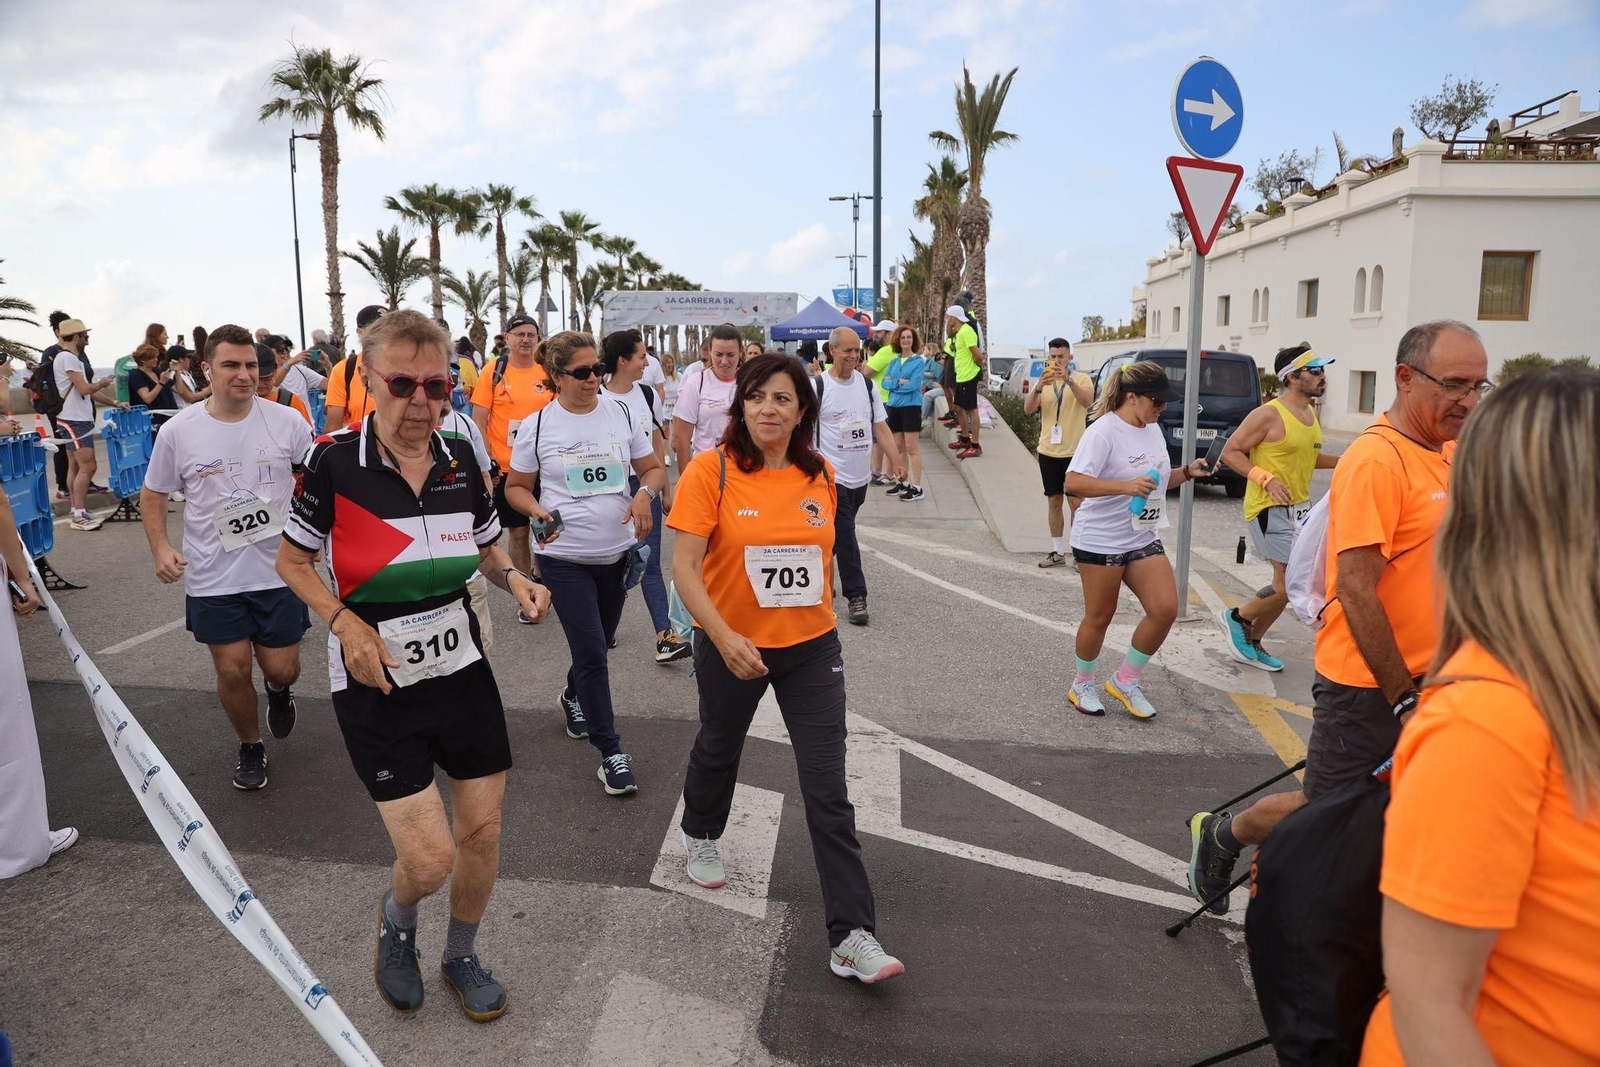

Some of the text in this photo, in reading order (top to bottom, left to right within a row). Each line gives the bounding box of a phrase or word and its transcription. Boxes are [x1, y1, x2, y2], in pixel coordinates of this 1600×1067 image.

[852, 429, 865, 439] 58
[583, 467, 607, 483] 66
[442, 482, 467, 490] PALESTINE
[230, 498, 252, 509] CARRERA
[303, 491, 320, 506] RIDE
[228, 510, 270, 535] 320
[440, 532, 474, 542] PALESTI
[761, 566, 810, 589] 703
[412, 610, 442, 624] CARRERA
[404, 628, 459, 665] 310
[211, 864, 216, 874] de
[260, 928, 308, 994] Ayuntamiento de Málaga
